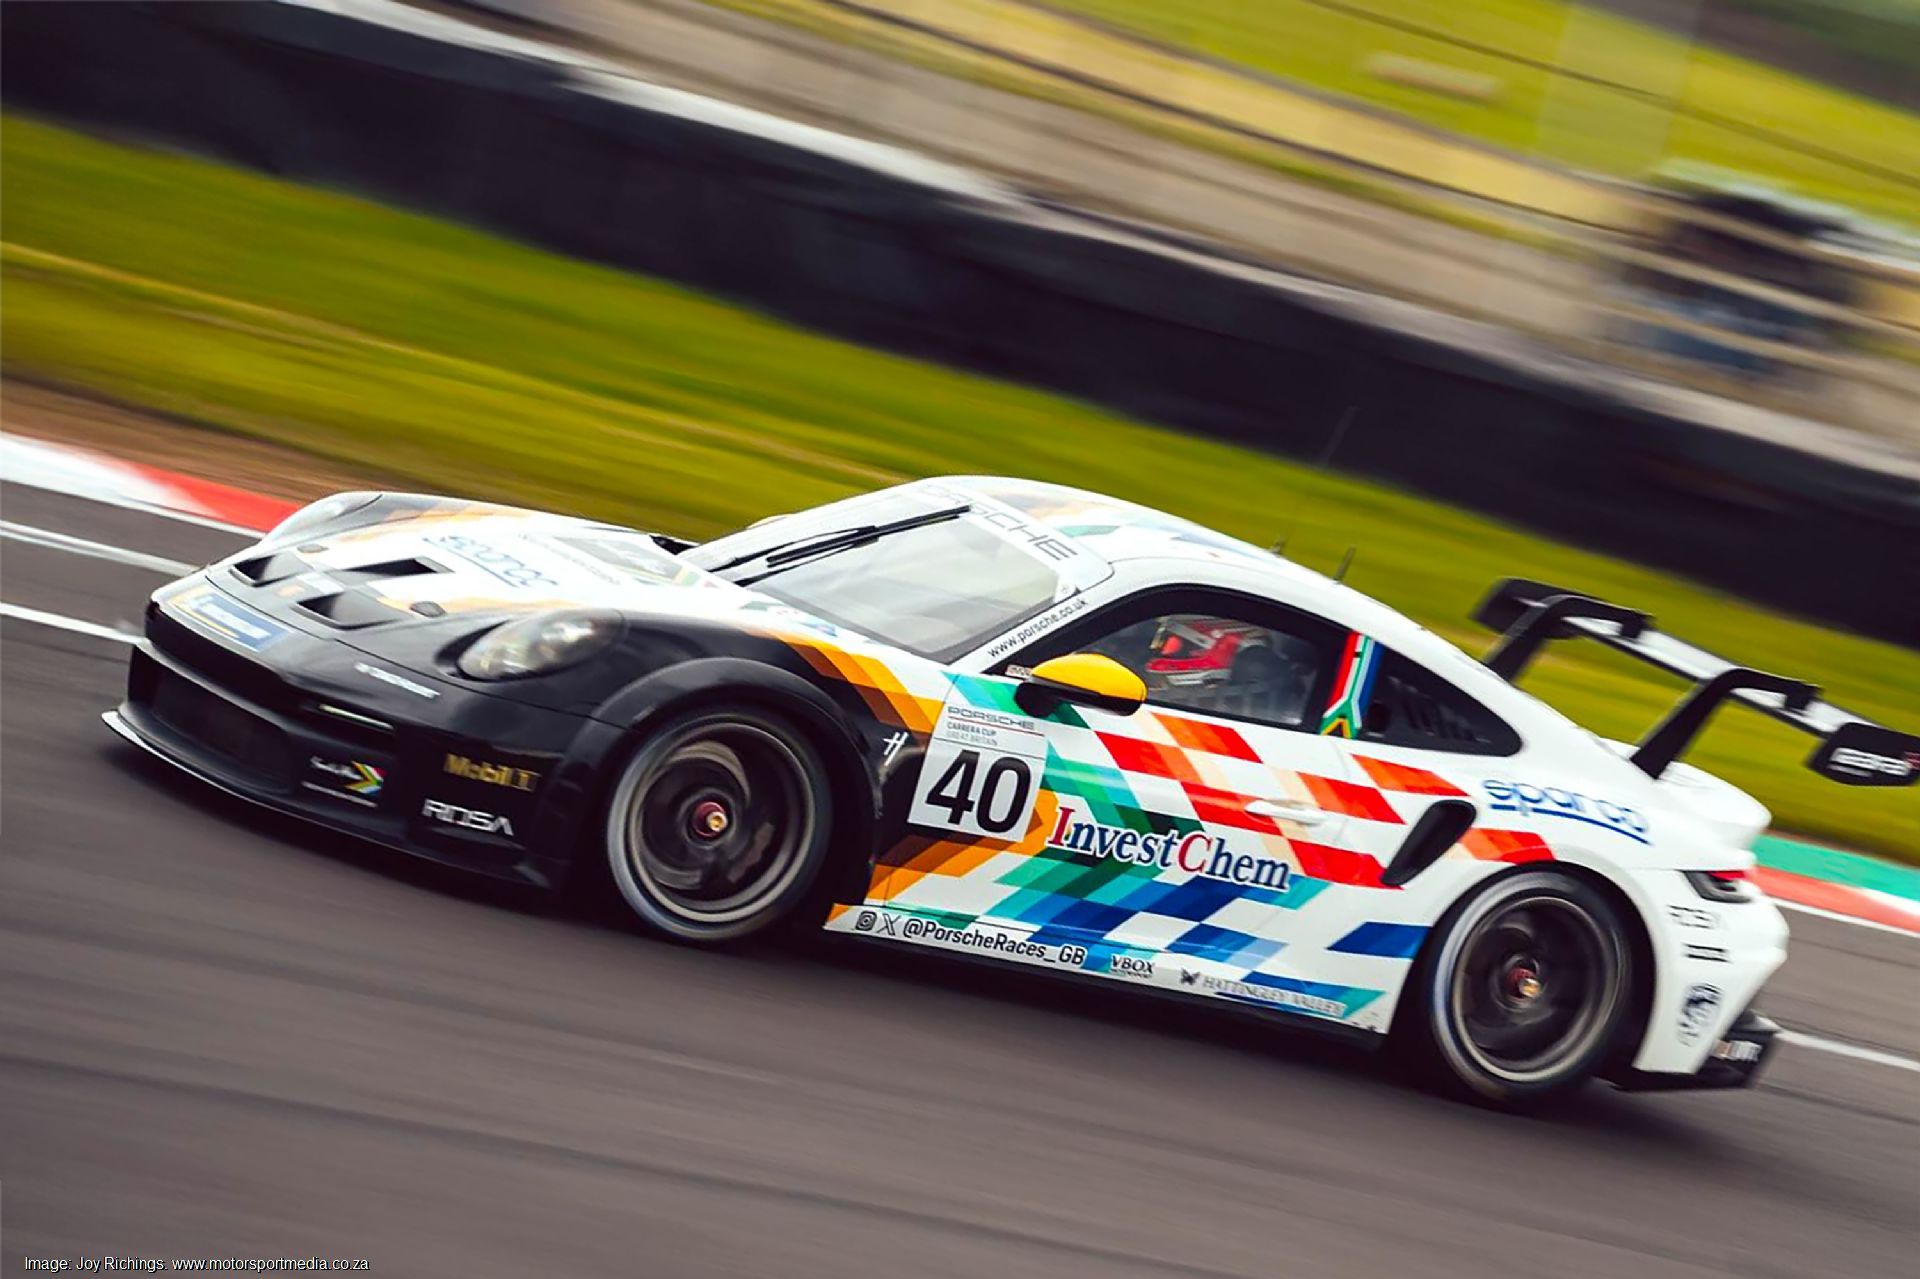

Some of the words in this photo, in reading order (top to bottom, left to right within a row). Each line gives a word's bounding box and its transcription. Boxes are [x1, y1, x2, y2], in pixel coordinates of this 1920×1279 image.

[987, 599, 1088, 658] www.porsche.co.uk
[947, 706, 1035, 730] PORSCHE
[947, 721, 981, 734] CARRERA
[982, 727, 997, 737] CUP
[443, 753, 513, 787] Mobil
[925, 749, 1031, 833] 40
[421, 798, 514, 836] ROSA
[1484, 779, 1649, 833] sparco
[1047, 806, 1290, 891] InvestChem
[903, 918, 1086, 966] @PorscheRaces_GB
[1112, 955, 1155, 974] VBOX
